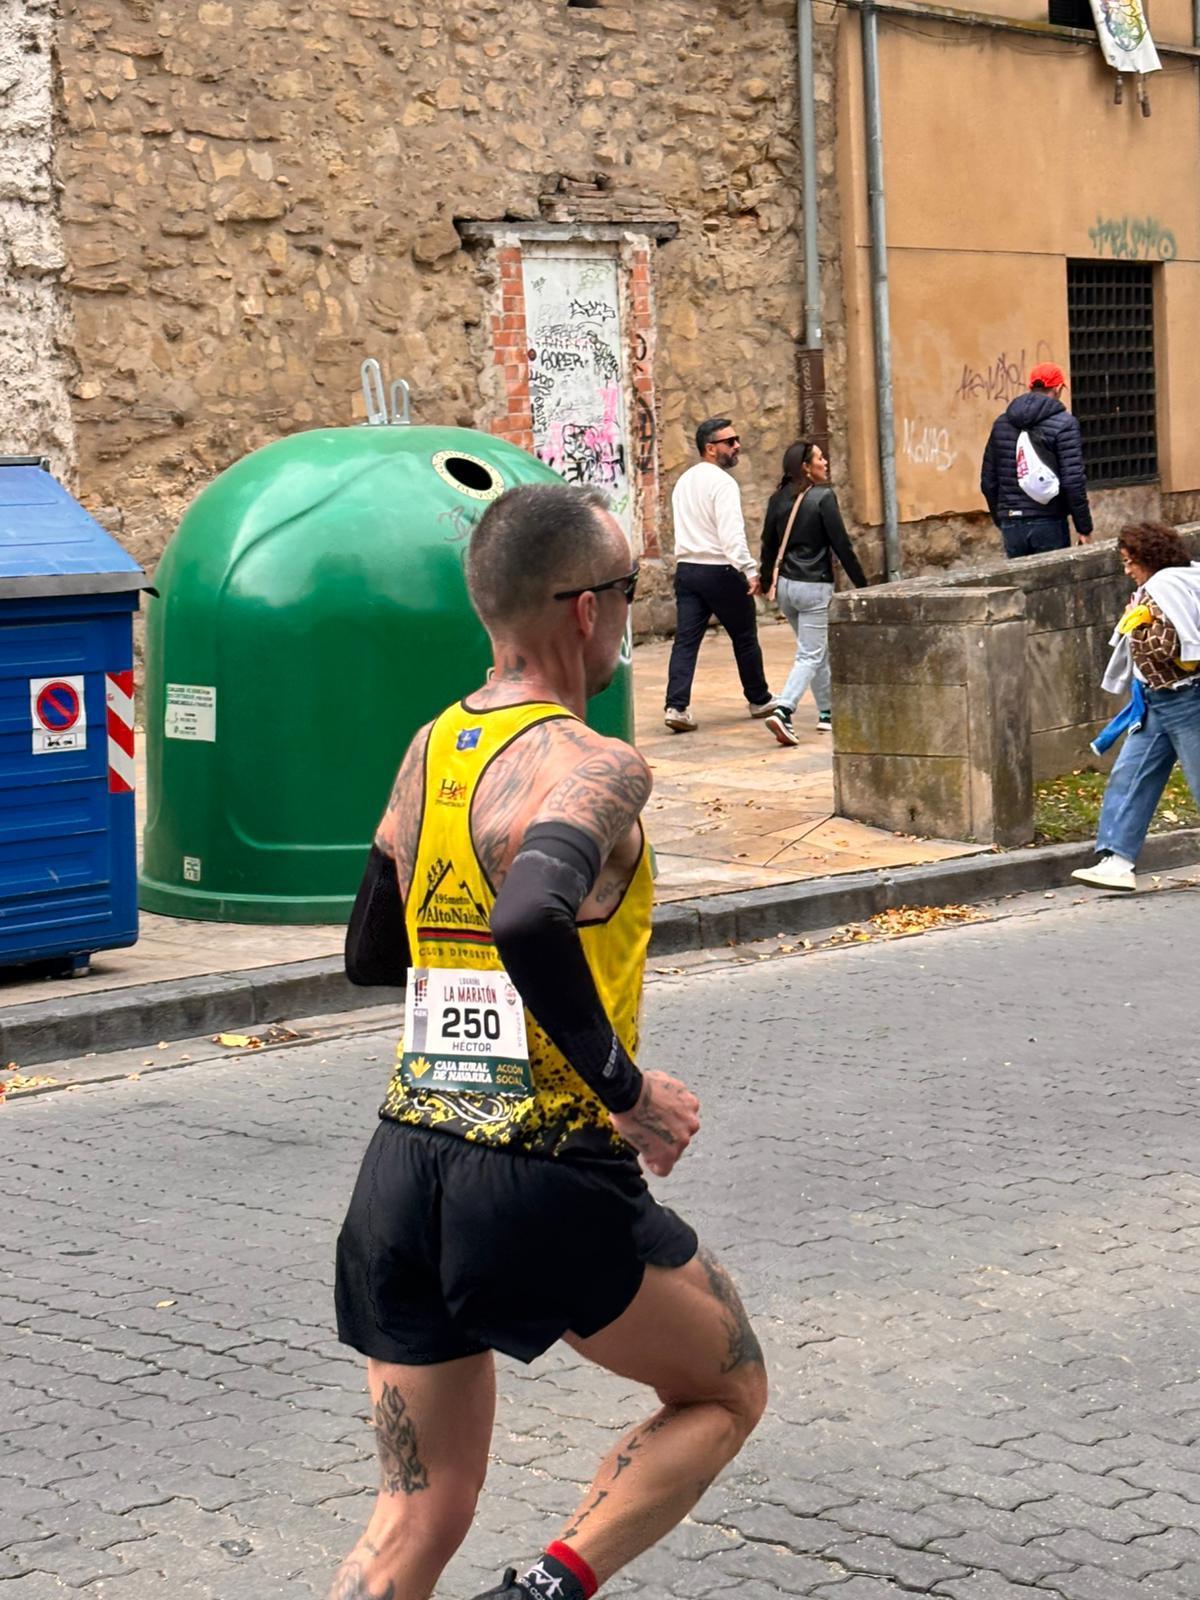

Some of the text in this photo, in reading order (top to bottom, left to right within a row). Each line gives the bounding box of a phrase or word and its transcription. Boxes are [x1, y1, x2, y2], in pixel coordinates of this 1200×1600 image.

[444, 985, 497, 1004] LA MARATÓN
[441, 1007, 500, 1040] 250
[452, 1041, 492, 1052] HÉCTOR
[434, 1060, 490, 1073] CAJA RURAL
[432, 1070, 493, 1084] DE NAVARRA
